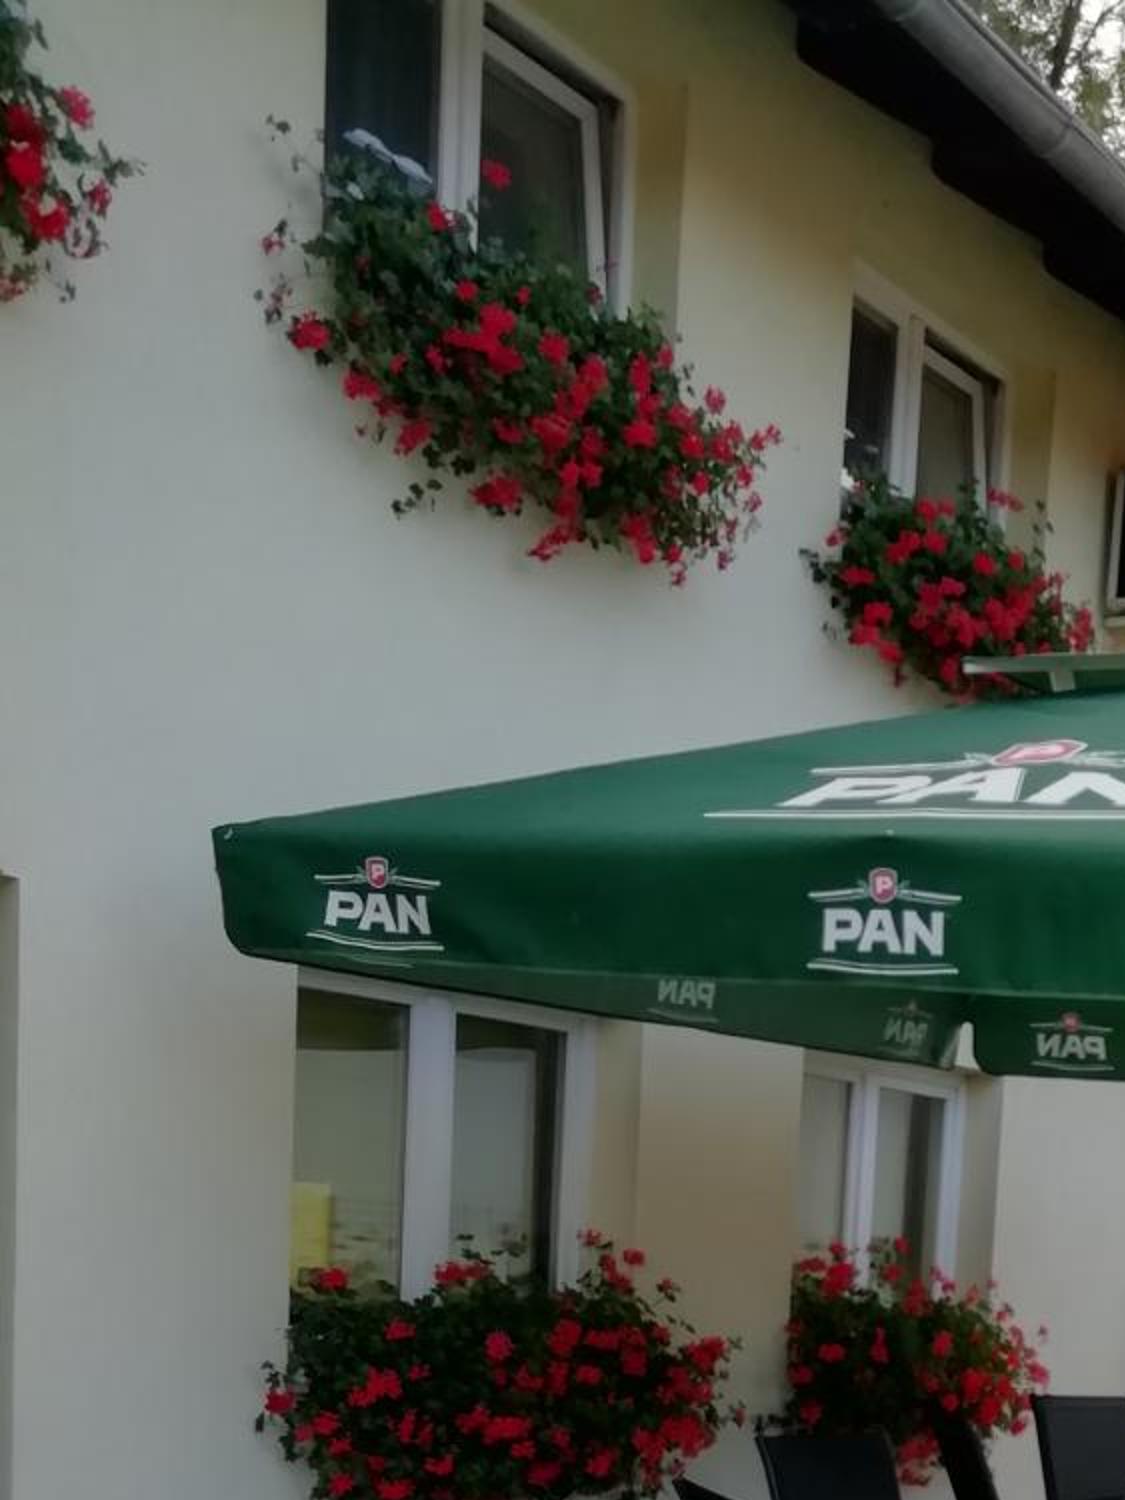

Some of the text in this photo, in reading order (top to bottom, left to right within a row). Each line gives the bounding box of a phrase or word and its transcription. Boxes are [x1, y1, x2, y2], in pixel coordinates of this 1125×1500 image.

[876, 875, 893, 895] P
[324, 889, 432, 935] PAN
[822, 907, 945, 956] PAN
